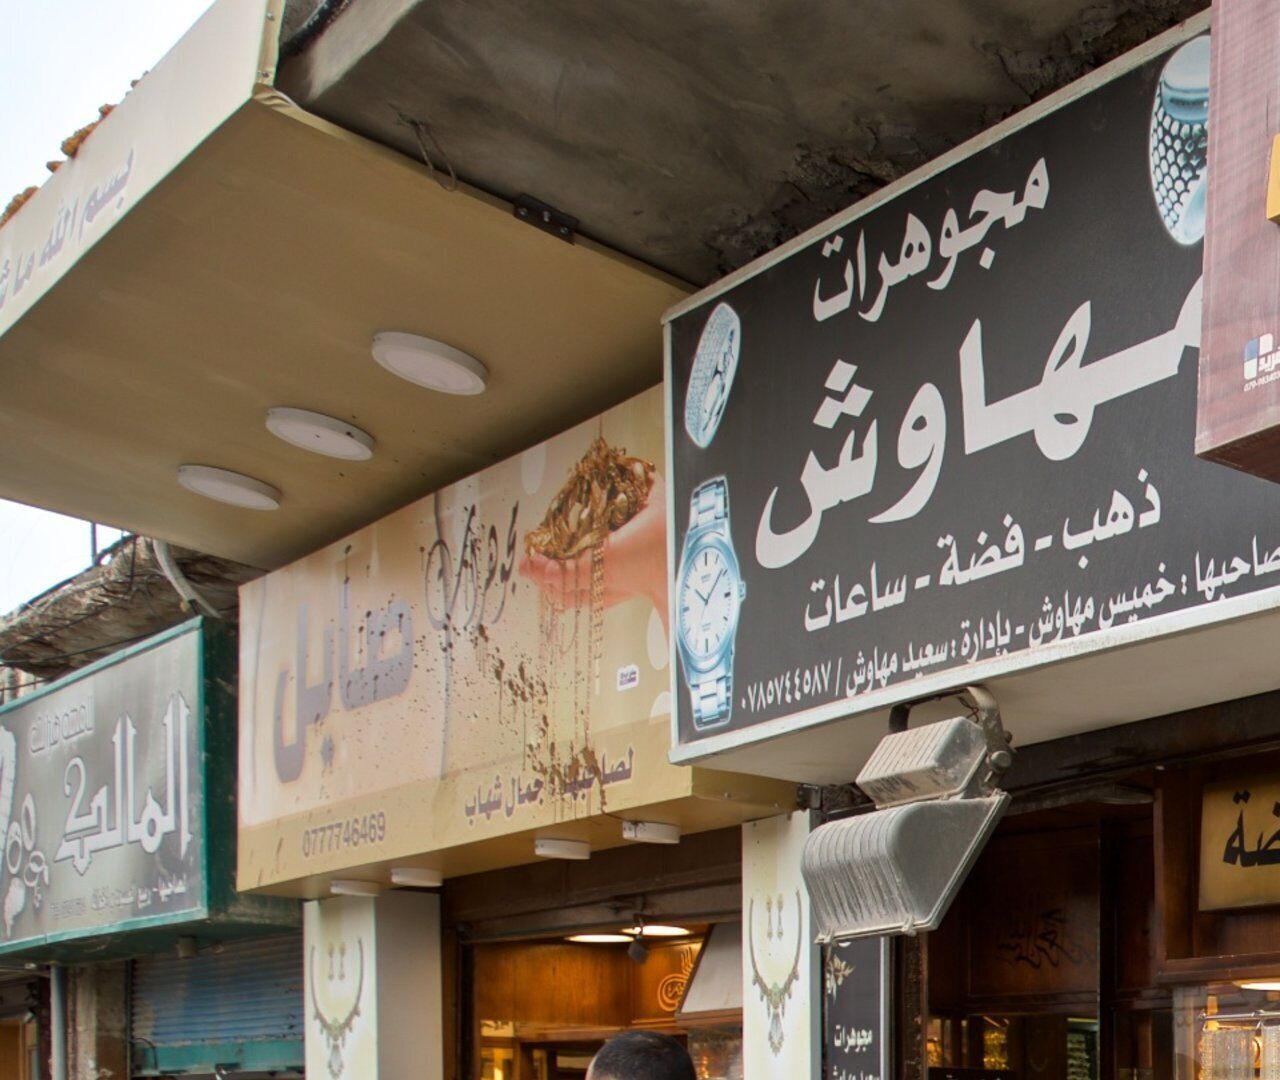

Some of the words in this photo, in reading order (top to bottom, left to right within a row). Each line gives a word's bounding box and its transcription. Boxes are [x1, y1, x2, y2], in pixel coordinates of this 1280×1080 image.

[813, 157, 1050, 322] مجوهرات
[1062, 468, 1161, 569] ذهب
[936, 513, 1025, 586] فضة
[804, 561, 907, 632] ساعات
[1029, 589, 1095, 648] مهاوش
[1098, 562, 1176, 629] خميس
[846, 646, 898, 699] مهاوش
[902, 641, 948, 679] سعيد
[465, 774, 502, 826] شهاب
[505, 775, 544, 818] جمال
[303, 811, 386, 858] 0777746469
[834, 1024, 873, 1053] مجوهرات
